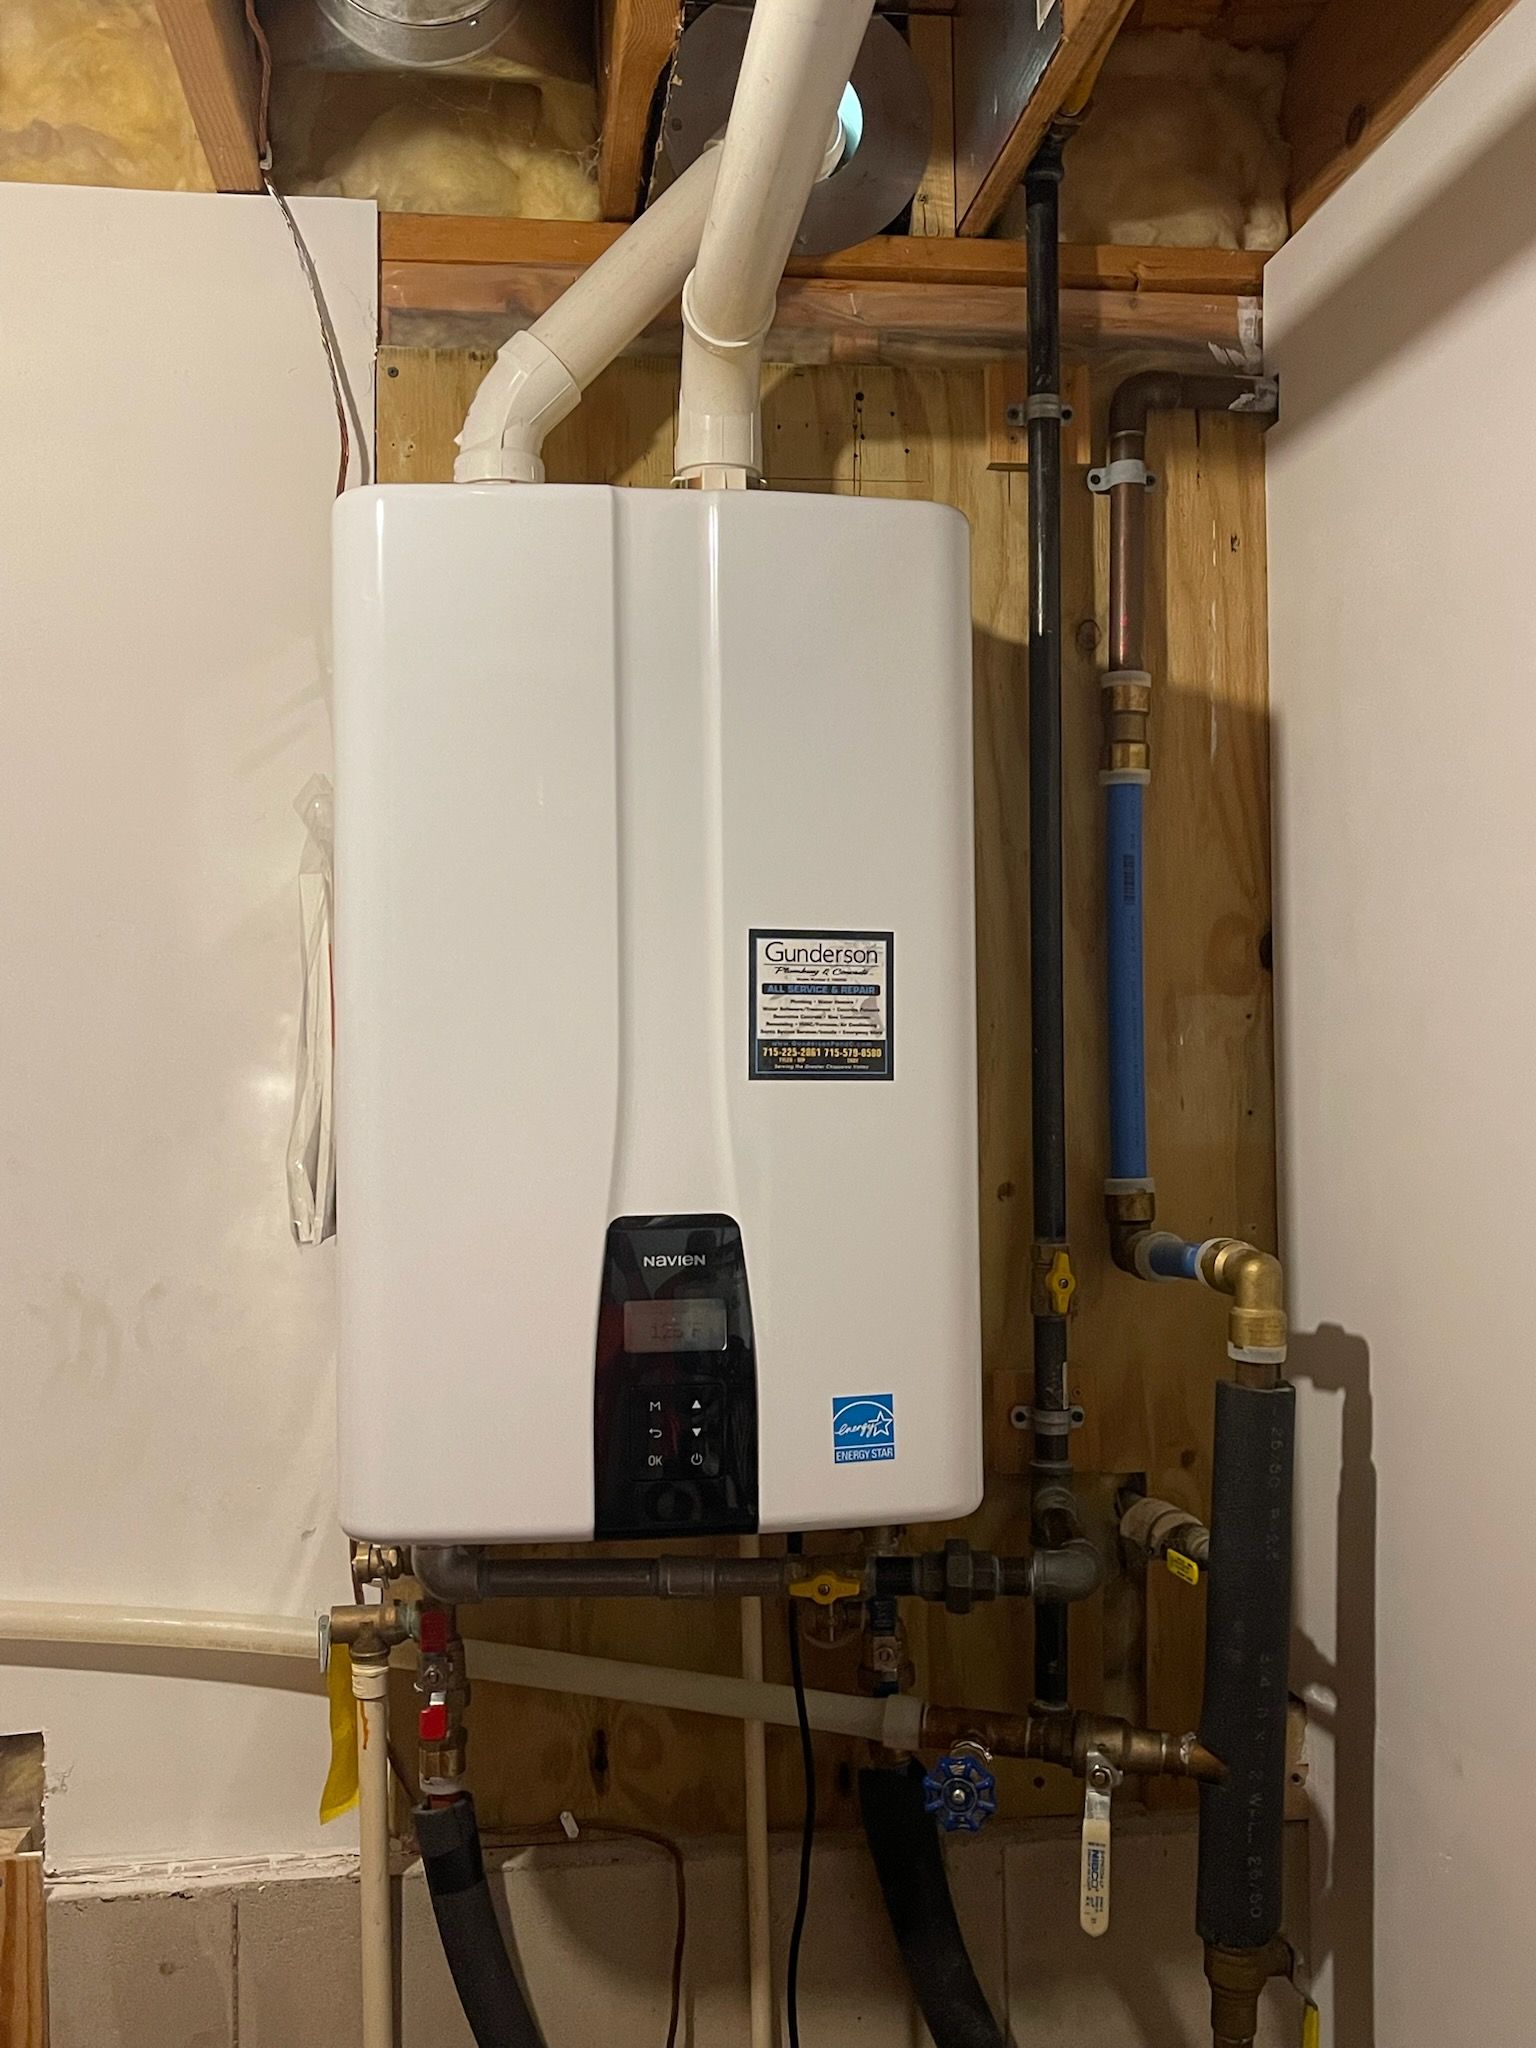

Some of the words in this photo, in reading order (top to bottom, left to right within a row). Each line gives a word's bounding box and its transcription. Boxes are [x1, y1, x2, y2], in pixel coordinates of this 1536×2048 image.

[765, 941, 878, 963] Gunderson
[767, 985, 785, 993] ALL
[787, 985, 828, 994] SERVICE
[831, 986, 838, 994] &
[841, 986, 876, 995] REPAIR
[649, 1401, 661, 1412] M
[647, 1454, 662, 1467] OK
[836, 1448, 871, 1462] ENERGY
[871, 1447, 894, 1459] STAR
